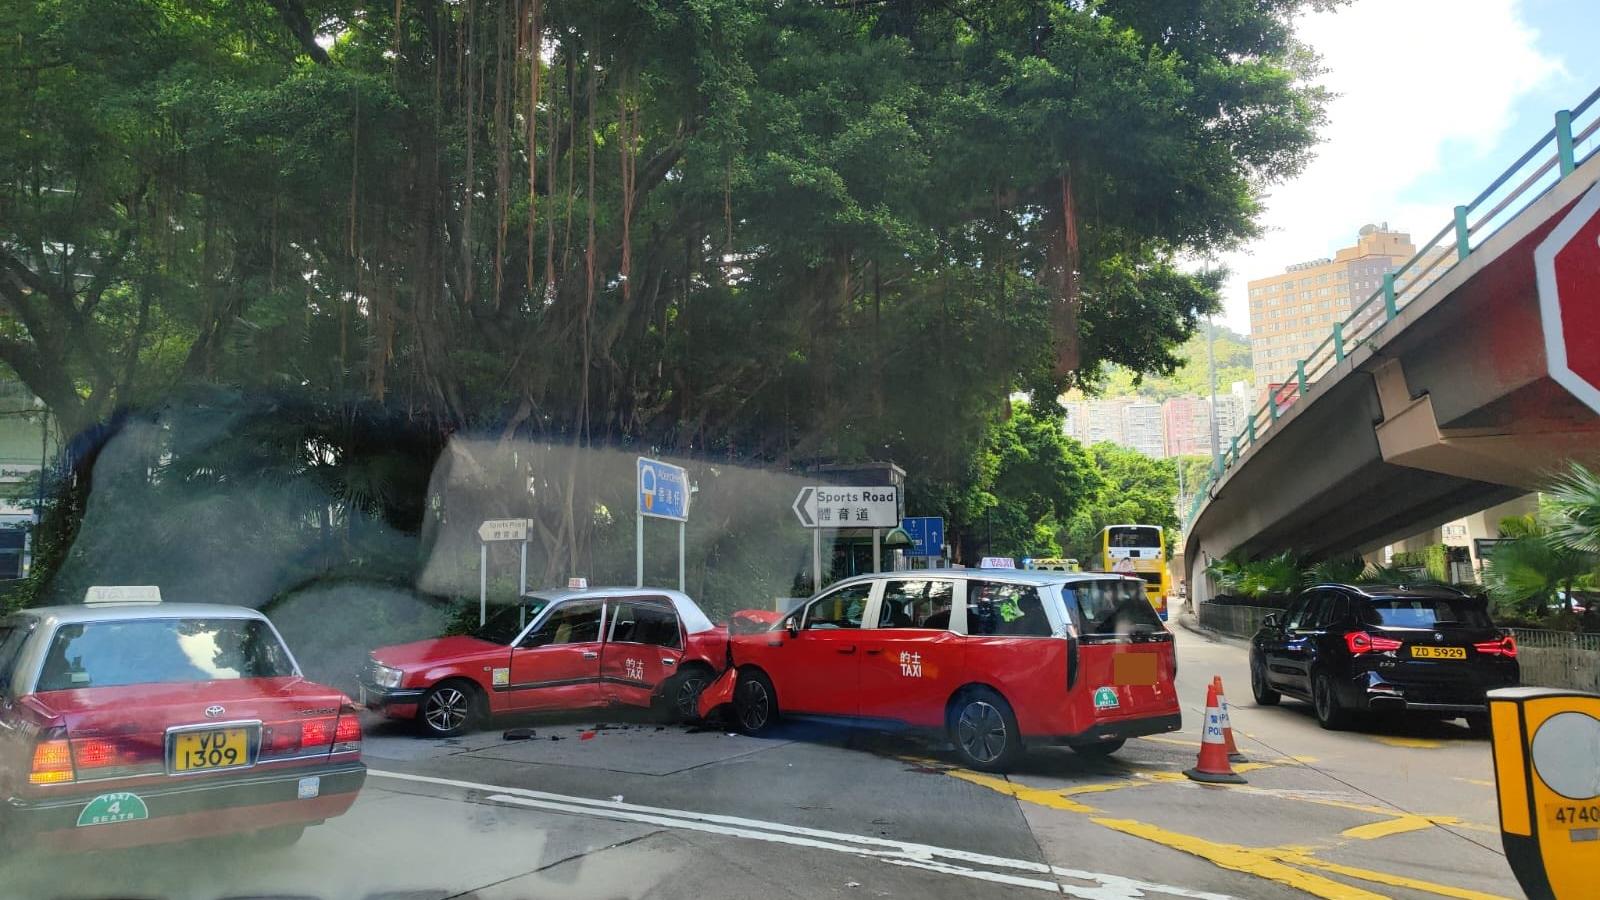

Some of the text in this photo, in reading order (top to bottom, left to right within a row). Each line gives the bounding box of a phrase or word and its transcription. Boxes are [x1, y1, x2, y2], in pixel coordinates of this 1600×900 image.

[817, 491, 894, 503] Sports Road
[818, 507, 869, 521] 體育道
[900, 650, 921, 664] 的士
[1415, 647, 1463, 658] ZD 5929
[625, 657, 645, 670] 的士
[626, 667, 644, 680] TAXI
[900, 663, 922, 678] TAXI
[200, 731, 226, 750] VD
[185, 748, 238, 770] 1309
[107, 801, 120, 814] 4
[92, 812, 134, 823] SEATS
